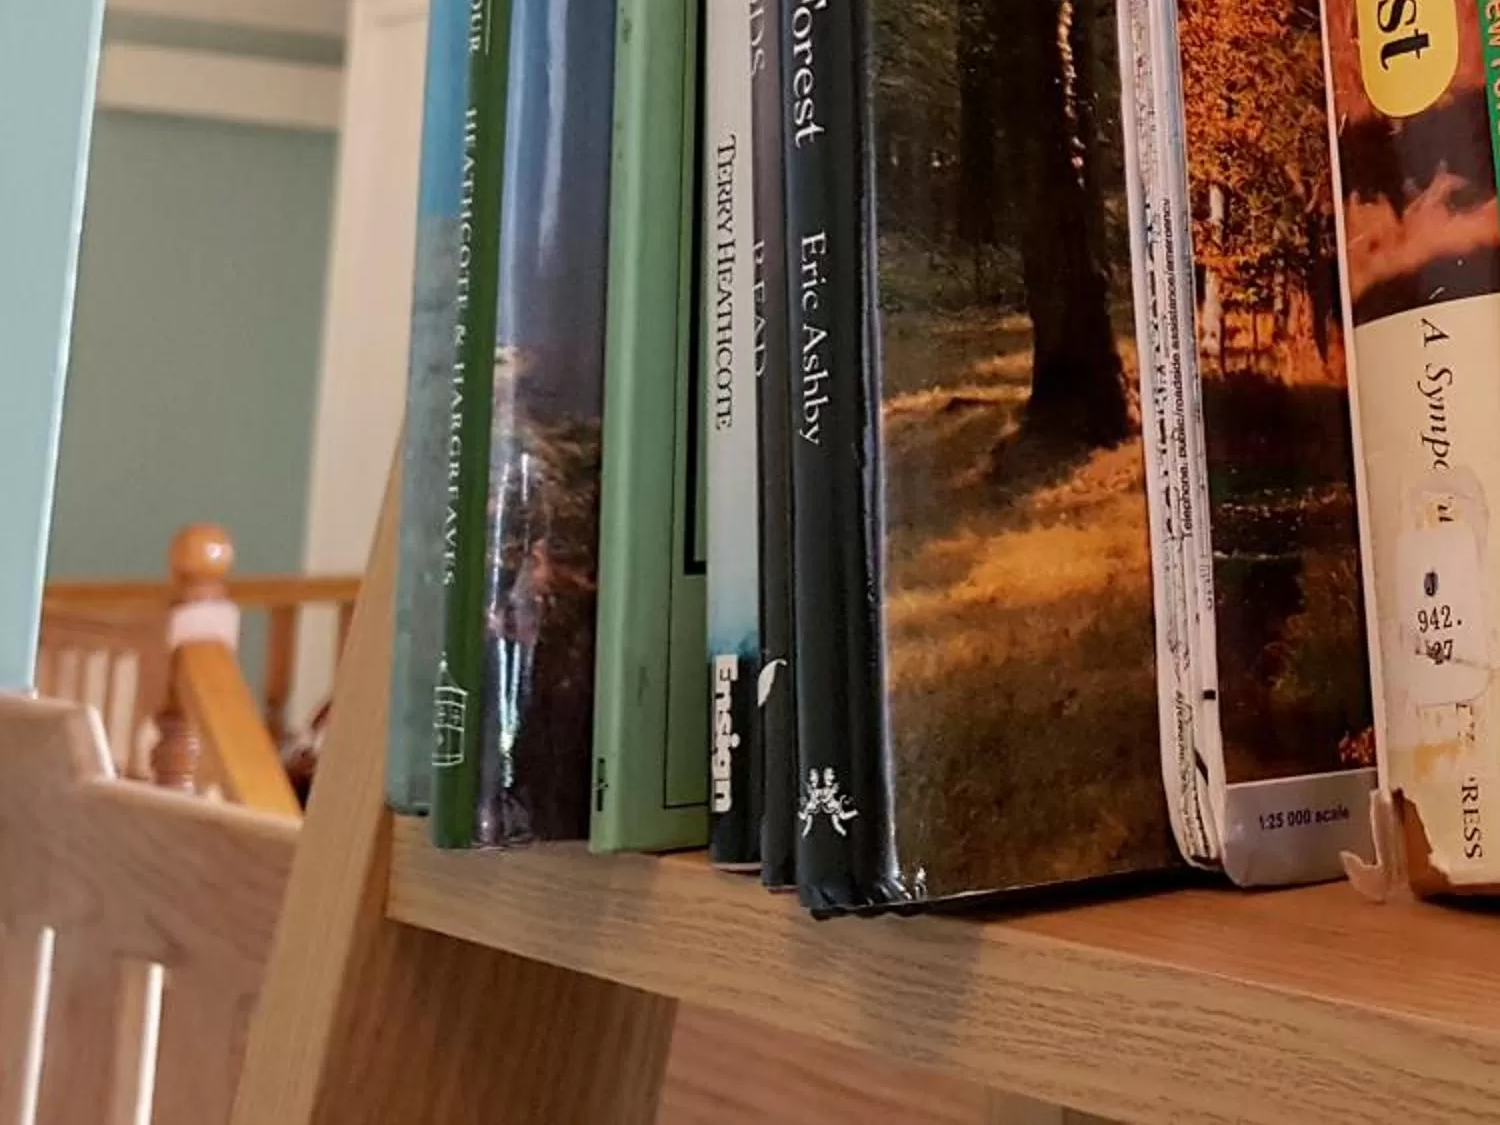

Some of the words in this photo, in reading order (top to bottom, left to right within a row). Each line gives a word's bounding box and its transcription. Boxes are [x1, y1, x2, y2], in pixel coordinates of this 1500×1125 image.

[457, 108, 478, 309] HEATHCOTE
[716, 132, 736, 233] TERRY
[800, 230, 828, 312] Eric
[715, 238, 736, 431] HEATHCOTE
[1421, 317, 1450, 348] A
[799, 323, 829, 445] Ashby
[443, 362, 465, 586] HARGREAVES
[1286, 808, 1311, 826] 000
[1314, 804, 1350, 823] scale
[1461, 775, 1484, 861] RESS
